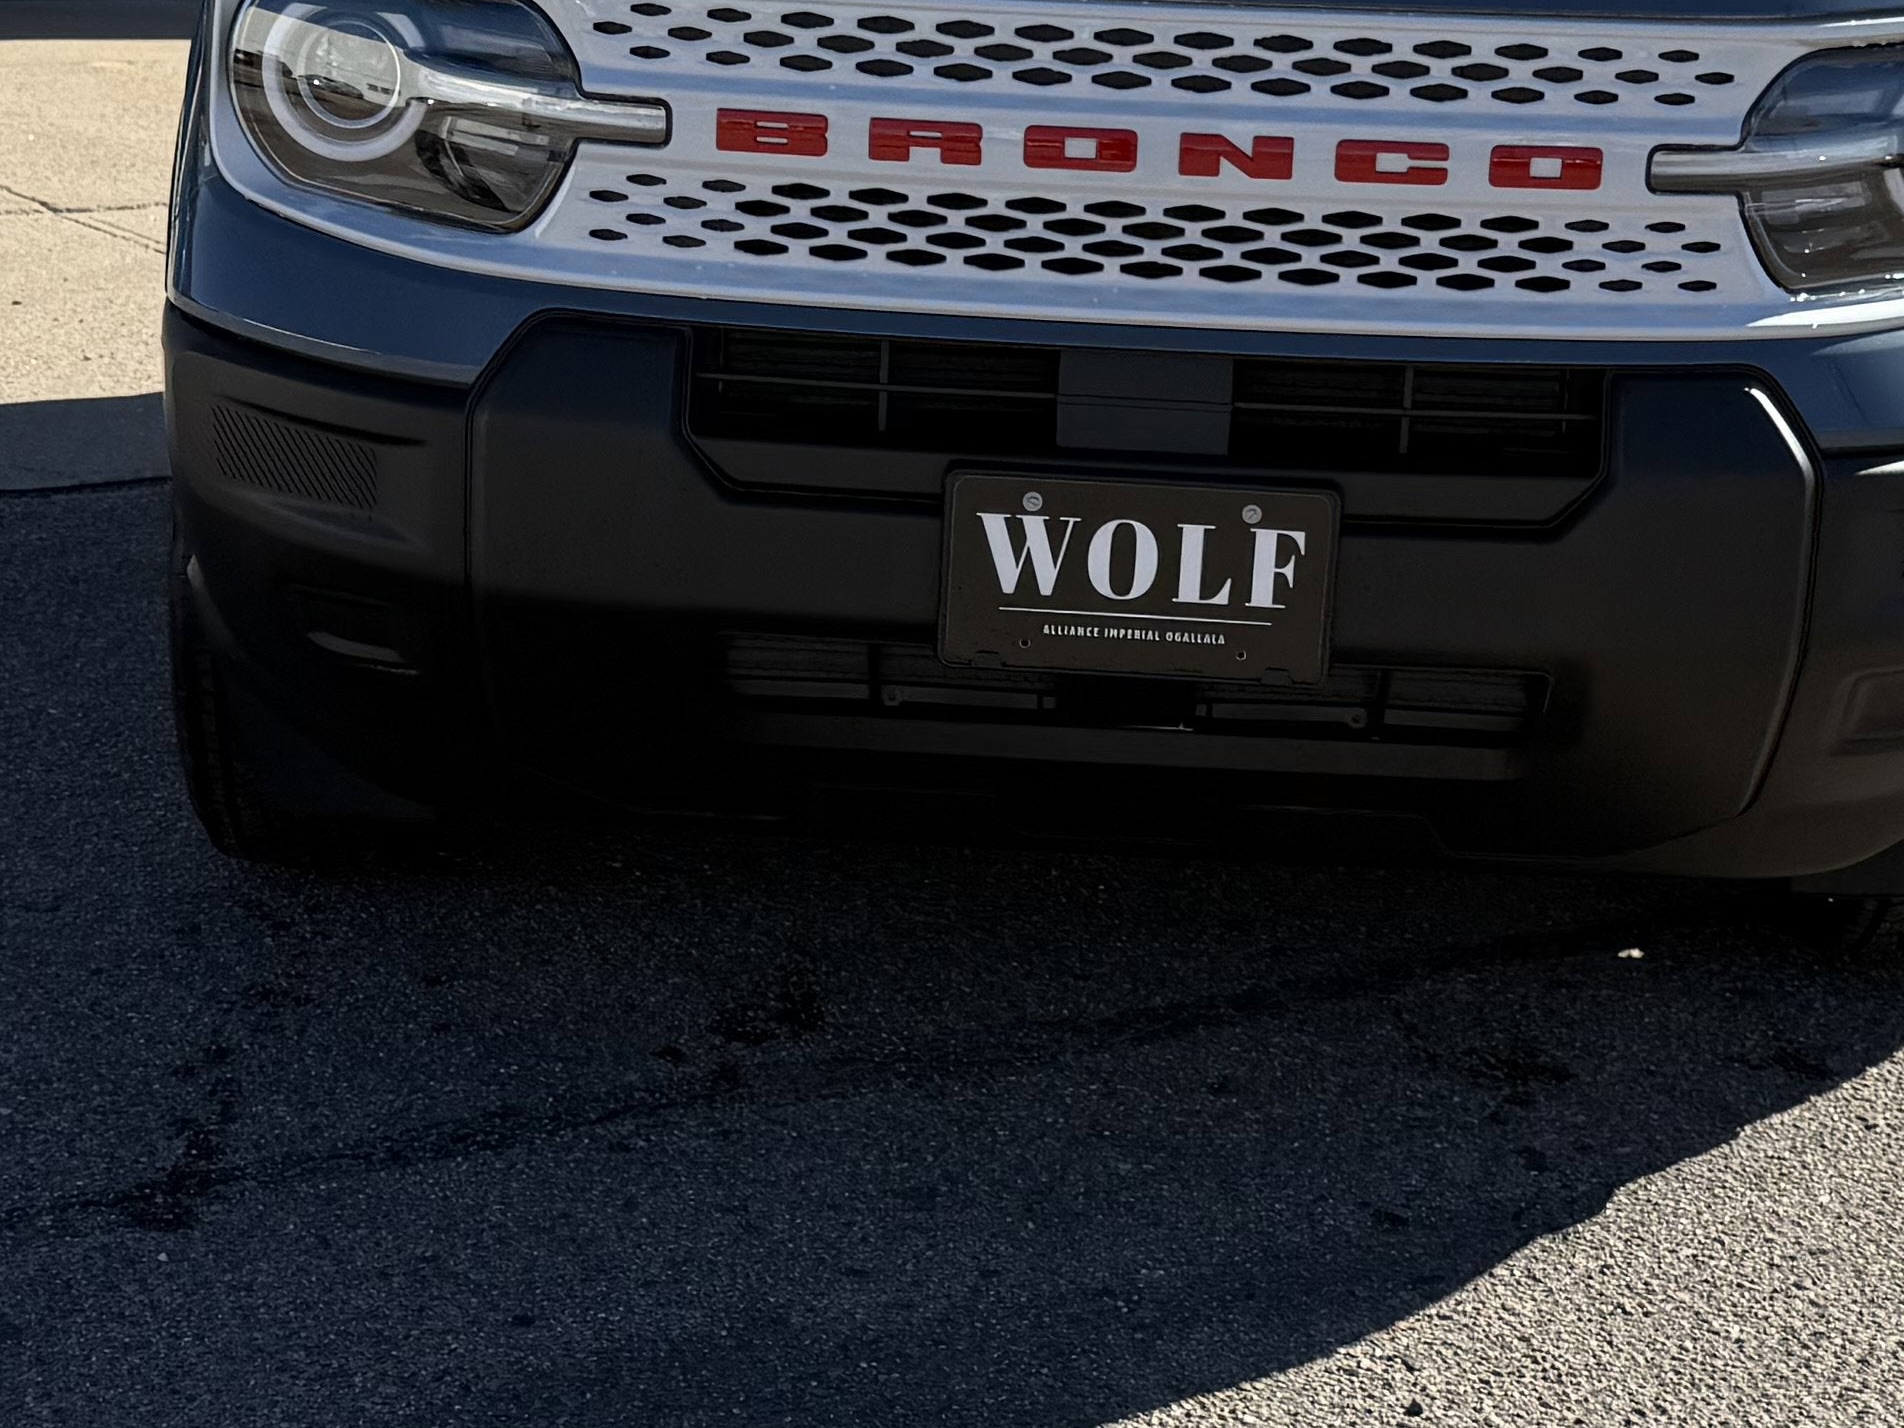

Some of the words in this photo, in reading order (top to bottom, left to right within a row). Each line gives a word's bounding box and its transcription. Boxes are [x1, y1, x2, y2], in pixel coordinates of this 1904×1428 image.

[715, 107, 1604, 191] BRONCO
[976, 512, 1306, 609] WOLF
[1043, 624, 1100, 638] ALLIANCE
[1104, 627, 1160, 641] IMPERIAL
[1165, 630, 1226, 645] OGALLALA
